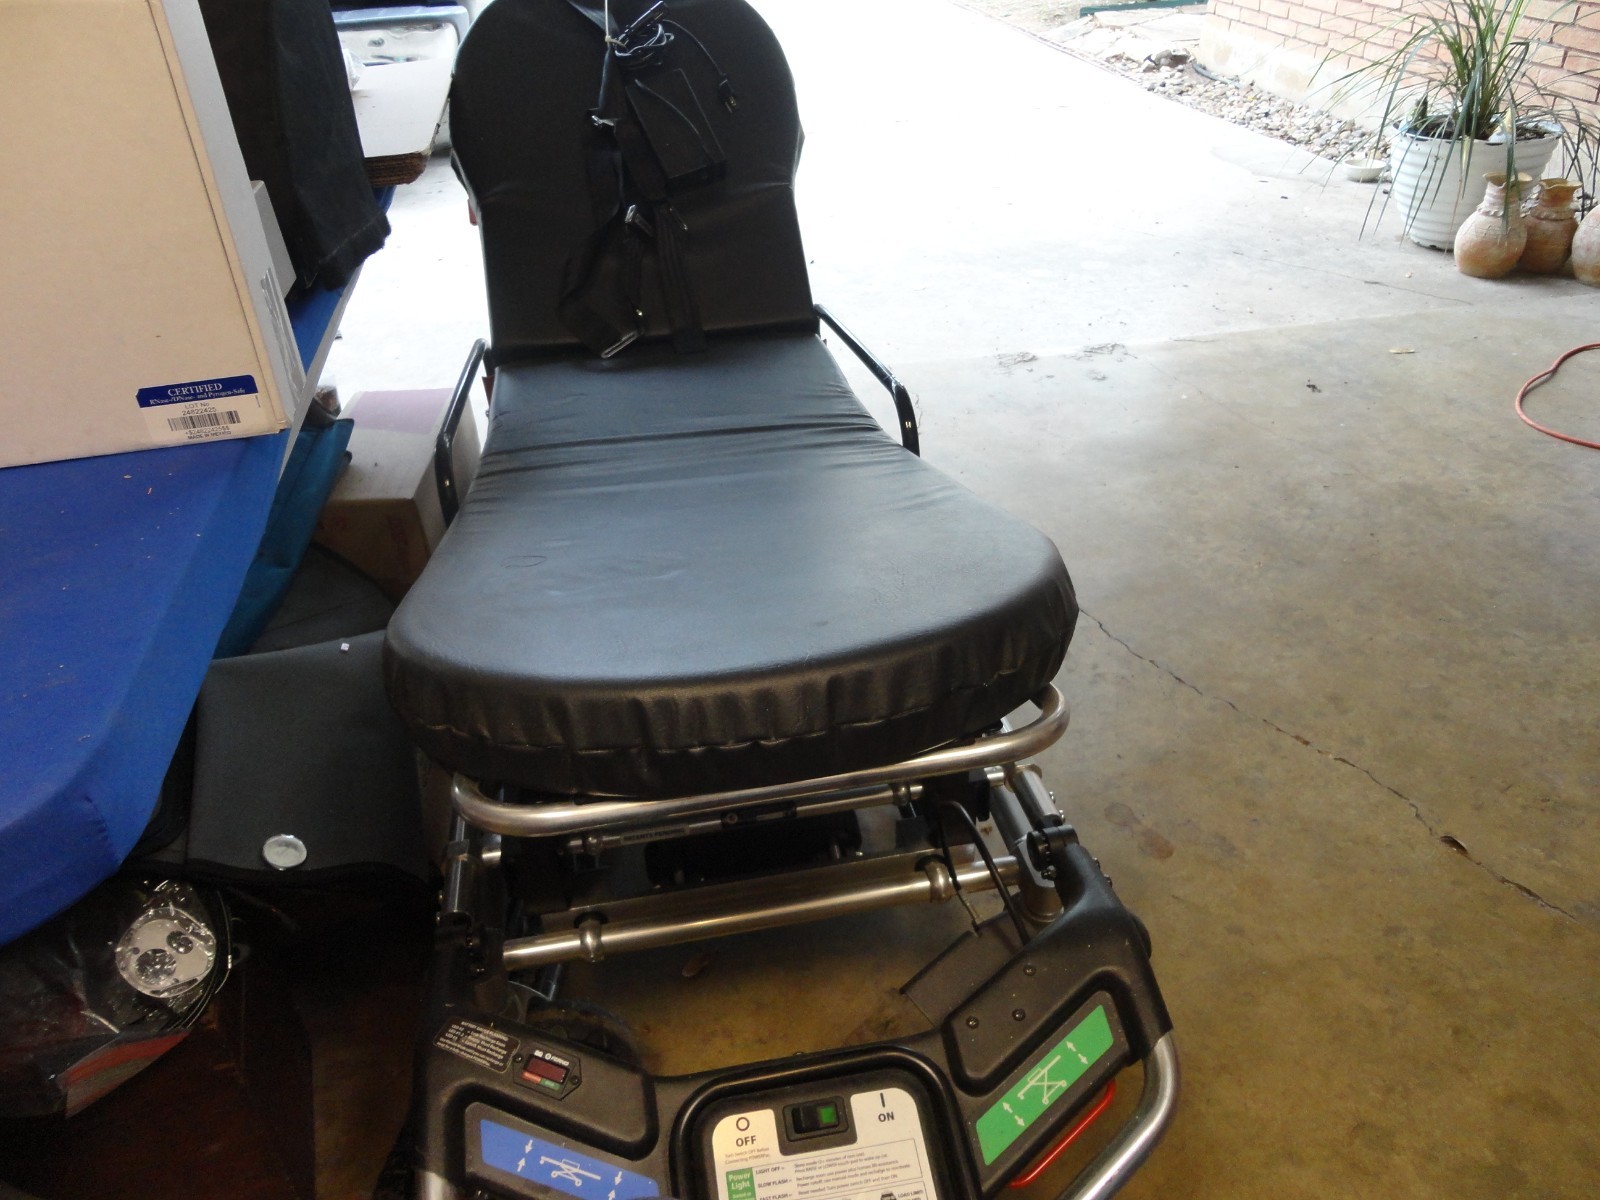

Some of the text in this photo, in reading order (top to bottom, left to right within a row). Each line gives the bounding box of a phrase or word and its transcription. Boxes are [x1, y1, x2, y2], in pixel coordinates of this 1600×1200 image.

[168, 383, 222, 397] CERTIFIED
[878, 1111, 895, 1123] ON
[736, 1135, 757, 1147] OFF
[728, 1172, 751, 1181] Power
[755, 1167, 770, 1175] LIGHT
[731, 1181, 751, 1191] Light
